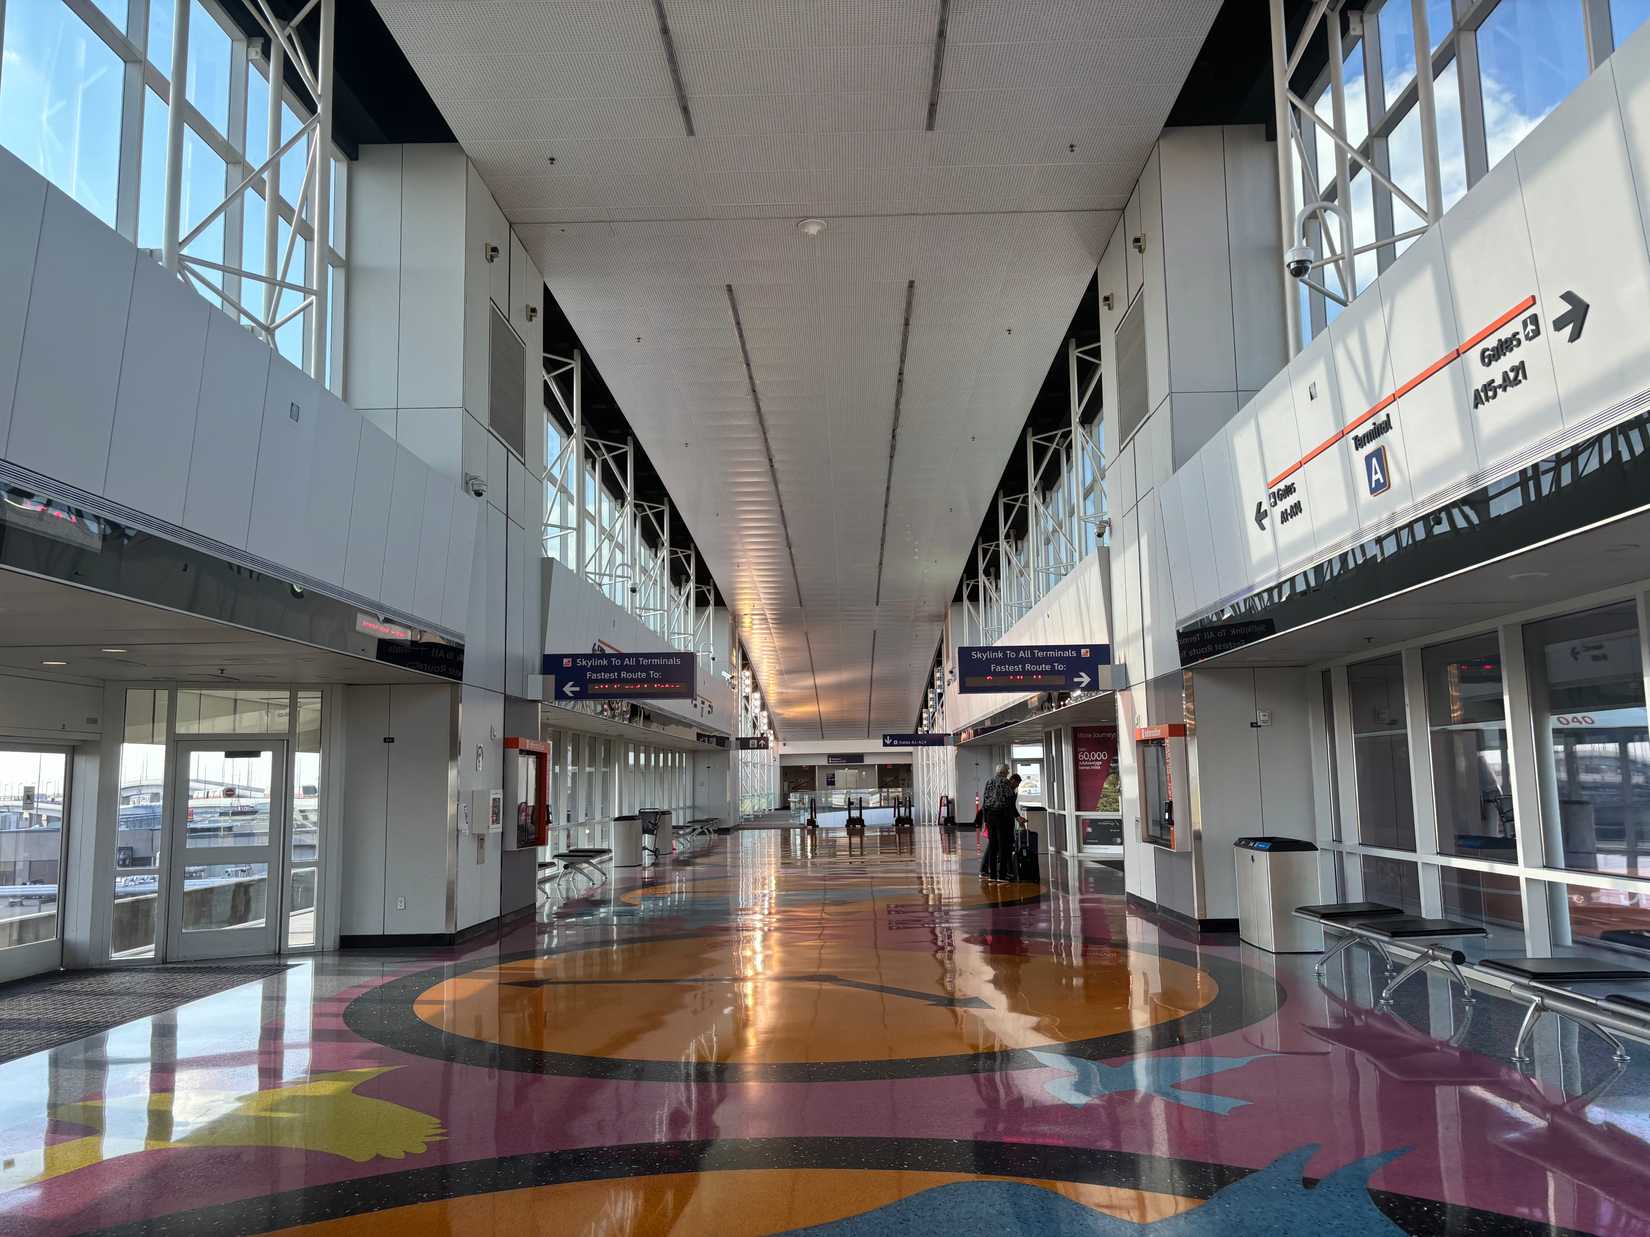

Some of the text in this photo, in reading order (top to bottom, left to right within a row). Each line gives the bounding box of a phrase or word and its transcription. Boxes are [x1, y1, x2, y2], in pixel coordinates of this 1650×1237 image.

[1480, 331, 1521, 367] Gates
[1473, 360, 1528, 410] A15-A21
[1352, 413, 1392, 451] Terminal
[1371, 456, 1384, 488] A
[1277, 482, 1297, 502] Gates
[576, 656, 681, 668] Skylink To All Terminals
[971, 649, 1077, 661] Skylink To All Terminals
[586, 670, 662, 680] Fastest Route To:
[991, 663, 1066, 672] Fastest Route To:
